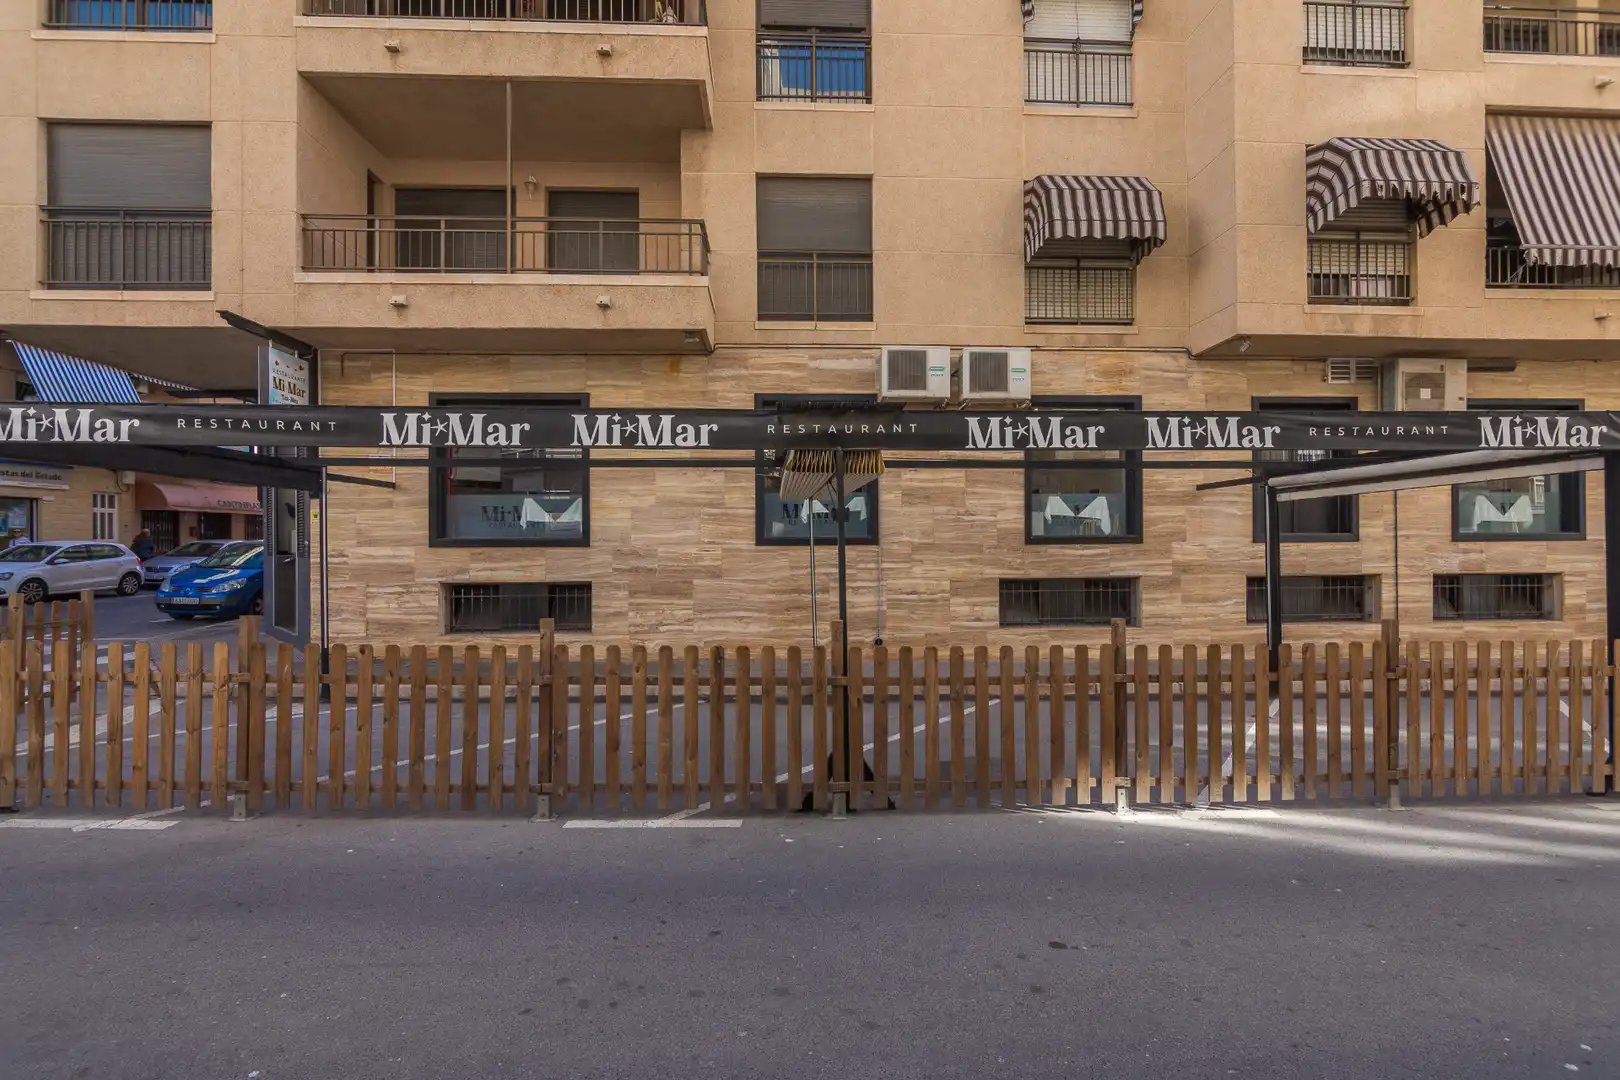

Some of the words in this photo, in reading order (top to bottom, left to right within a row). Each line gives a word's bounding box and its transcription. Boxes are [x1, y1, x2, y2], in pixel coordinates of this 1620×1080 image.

[273, 376, 285, 392] Mi
[288, 381, 306, 398] Mar
[51, 408, 140, 442] Mar
[177, 418, 338, 431] RESTAURANT
[380, 412, 434, 446] Mi
[445, 413, 530, 446] Mar
[571, 412, 624, 446] Mi
[634, 414, 718, 446] Mar
[767, 424, 919, 435] RESTAURANT
[965, 415, 1017, 448] Mi
[1026, 416, 1105, 448] Mar
[1145, 415, 1194, 448] Mi
[1204, 416, 1280, 448] Mar
[1309, 425, 1449, 436] RESTAURANT
[1479, 416, 1525, 448] Mi
[1534, 416, 1607, 448] Mar
[20, 470, 33, 479] del
